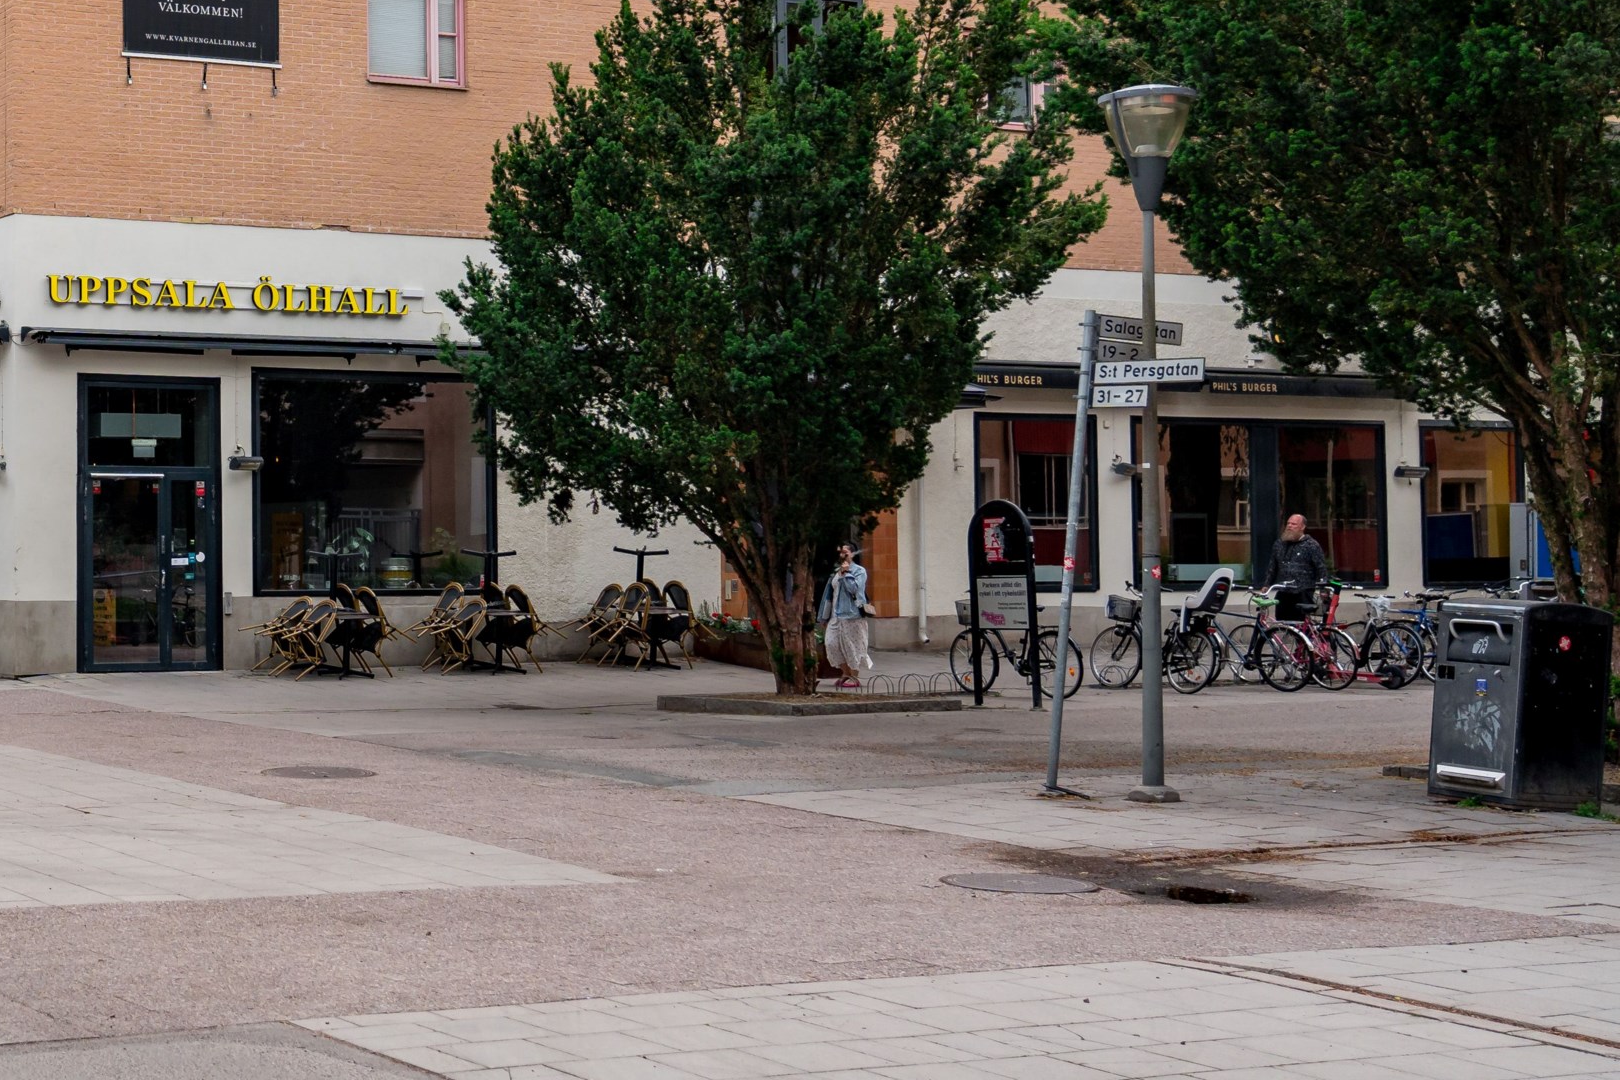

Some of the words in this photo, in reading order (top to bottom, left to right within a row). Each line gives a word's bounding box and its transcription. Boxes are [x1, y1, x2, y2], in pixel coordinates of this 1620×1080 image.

[158, 0, 243, 18] VÄLKOMMEN!
[47, 274, 235, 309] UPPSALA
[252, 276, 409, 315] ÖLHALL
[1105, 319, 1176, 339] Salagtan
[977, 374, 999, 384] HIL'S
[1004, 375, 1042, 385] BURGER
[1099, 365, 1118, 378] S:t
[1124, 363, 1198, 379] Persgatan
[1212, 382, 1237, 391] PHIL'S
[1242, 383, 1277, 392] BURGER
